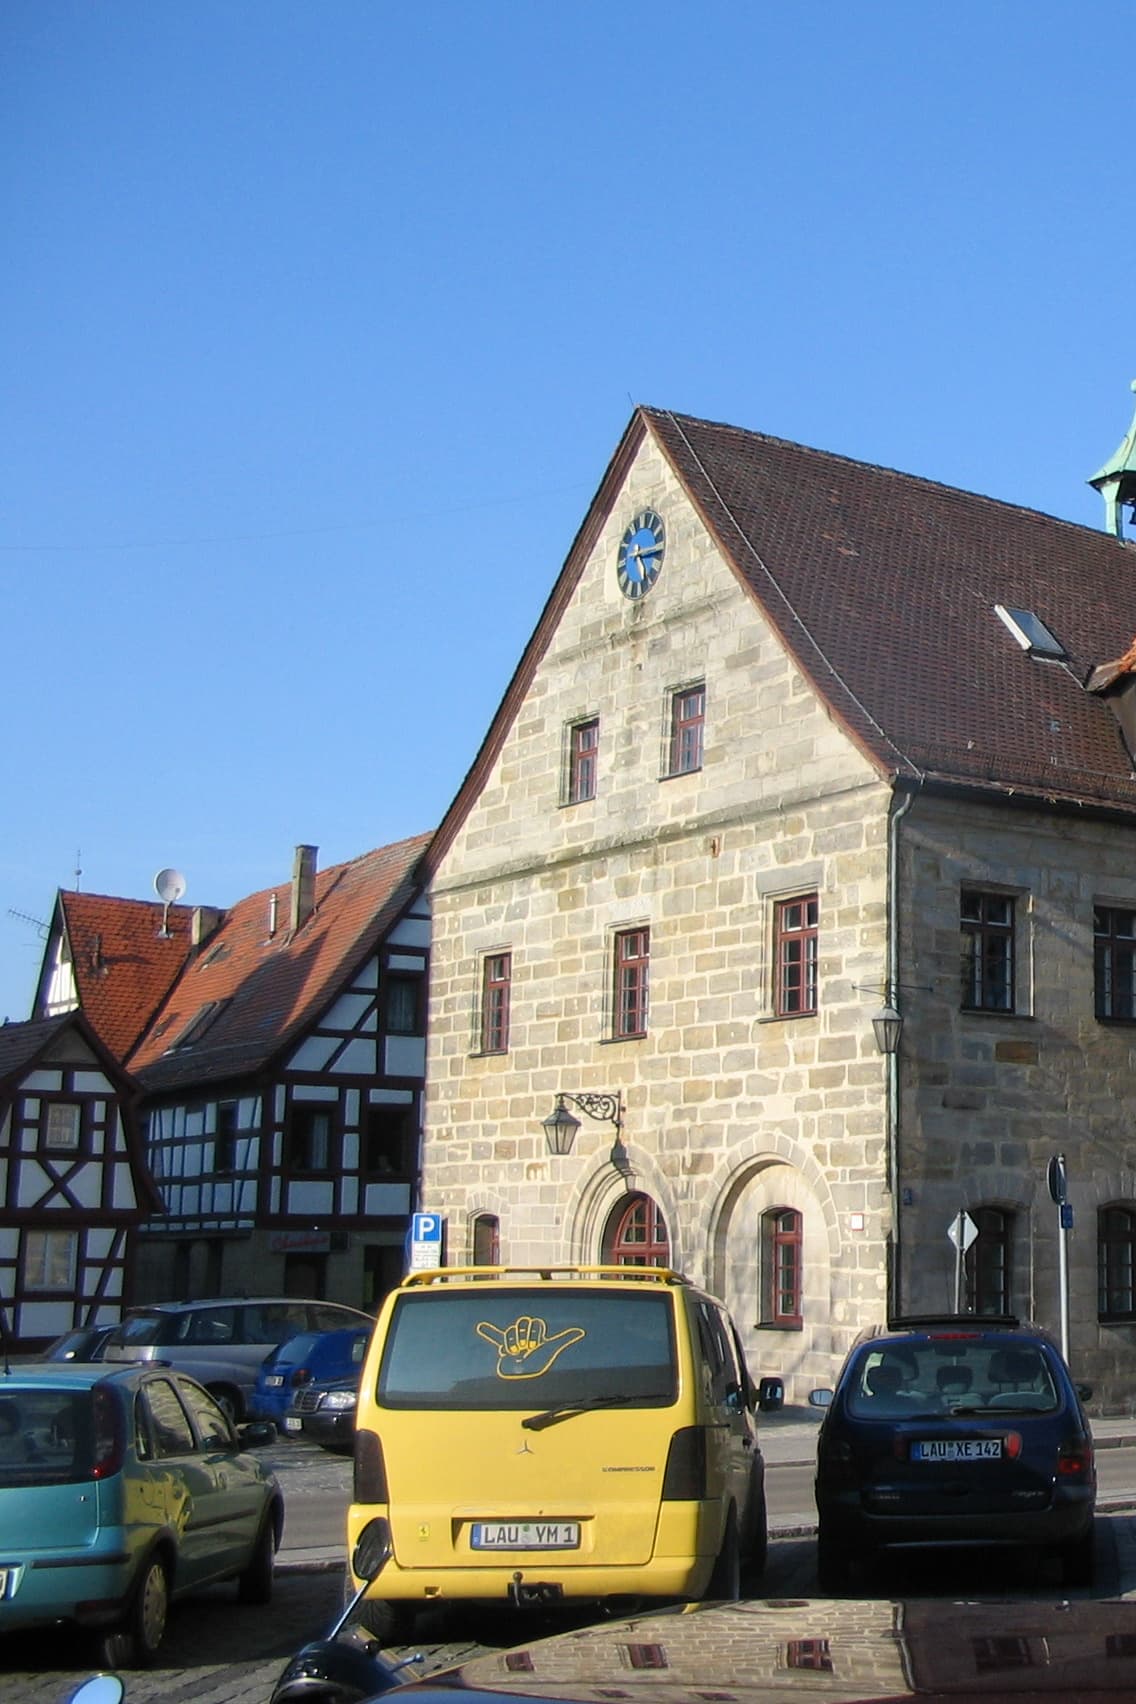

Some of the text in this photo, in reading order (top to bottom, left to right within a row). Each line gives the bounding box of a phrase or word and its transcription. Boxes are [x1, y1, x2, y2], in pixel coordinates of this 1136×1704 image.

[418, 1217, 435, 1241] P
[921, 1442, 1000, 1457] LAU XE 142
[484, 1525, 574, 1543] LAU YM 1
